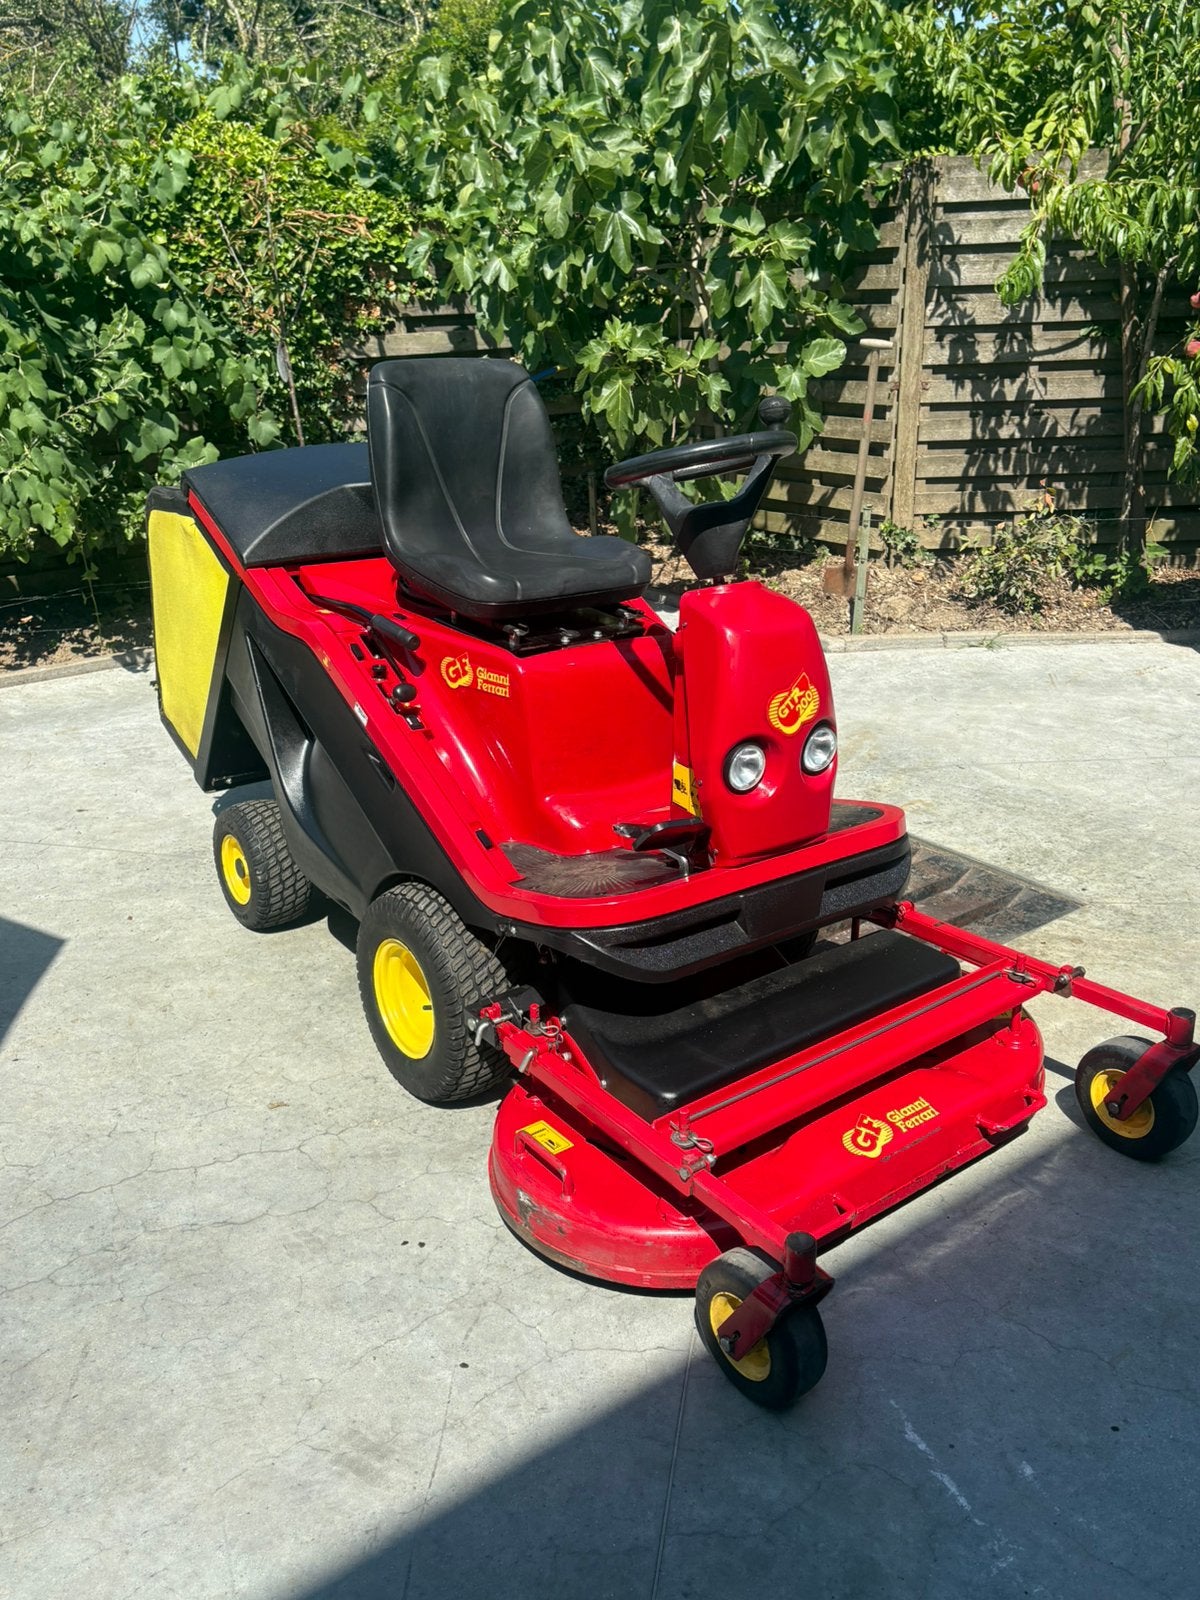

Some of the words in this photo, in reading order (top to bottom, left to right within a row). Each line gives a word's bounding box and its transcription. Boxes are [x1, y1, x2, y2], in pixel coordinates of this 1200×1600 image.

[476, 667, 510, 686] Gianni
[477, 679, 510, 698] Ferrari
[778, 687, 805, 718] GTR
[796, 690, 812, 715] 200
[886, 1096, 930, 1122] Gianni
[896, 1105, 940, 1133] Ferrari
